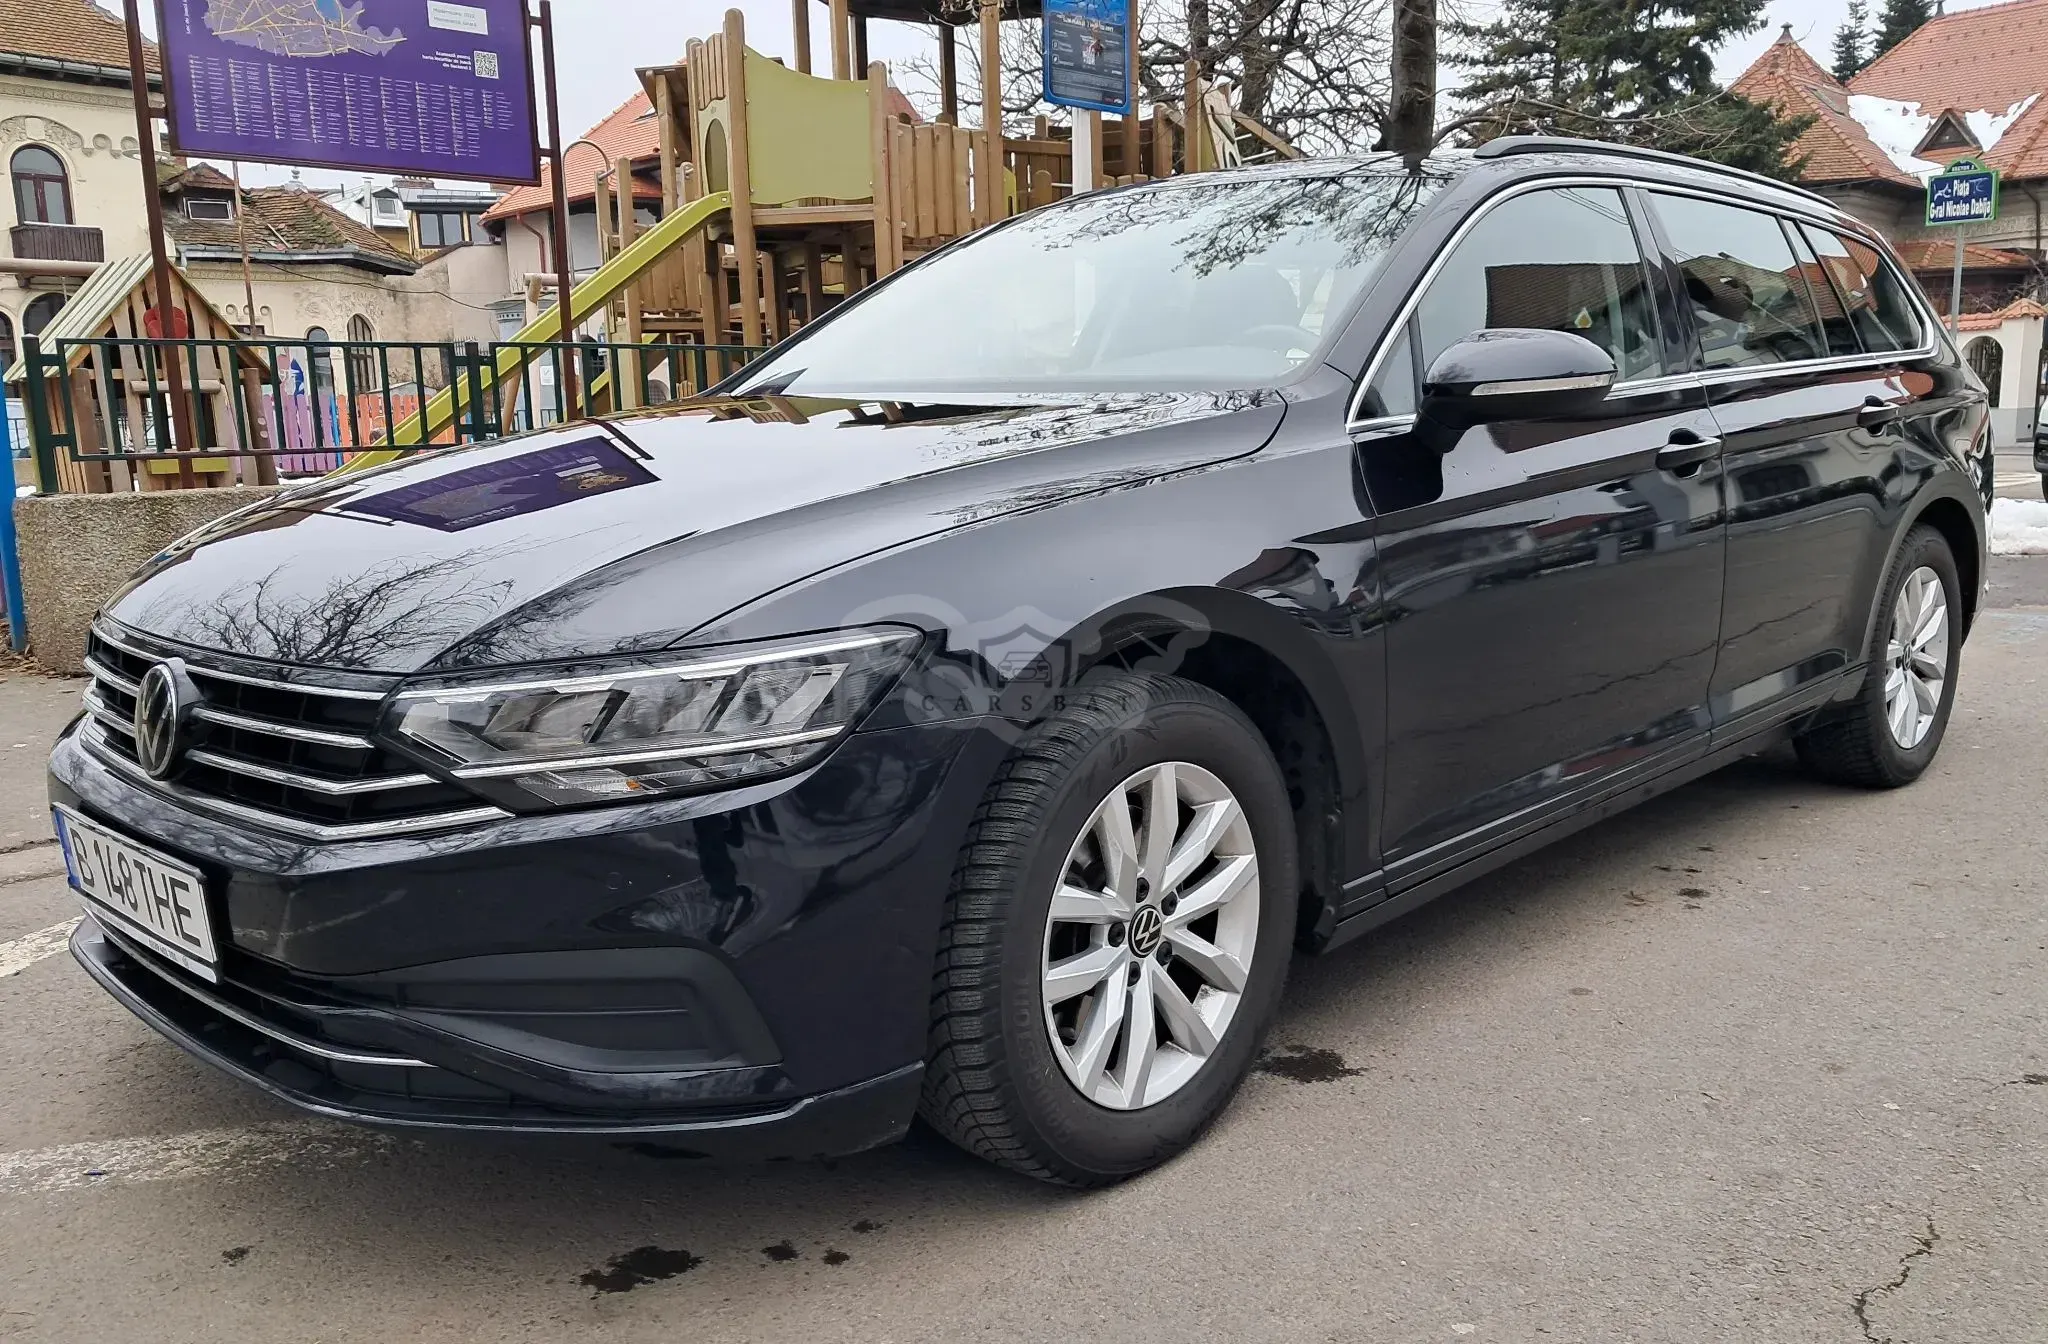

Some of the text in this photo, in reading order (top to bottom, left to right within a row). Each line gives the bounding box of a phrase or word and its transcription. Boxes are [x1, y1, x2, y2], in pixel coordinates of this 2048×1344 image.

[1946, 200, 1970, 218] Nicolae
[1971, 198, 1991, 218] Dabija
[70, 827, 202, 948] B 148 THE
